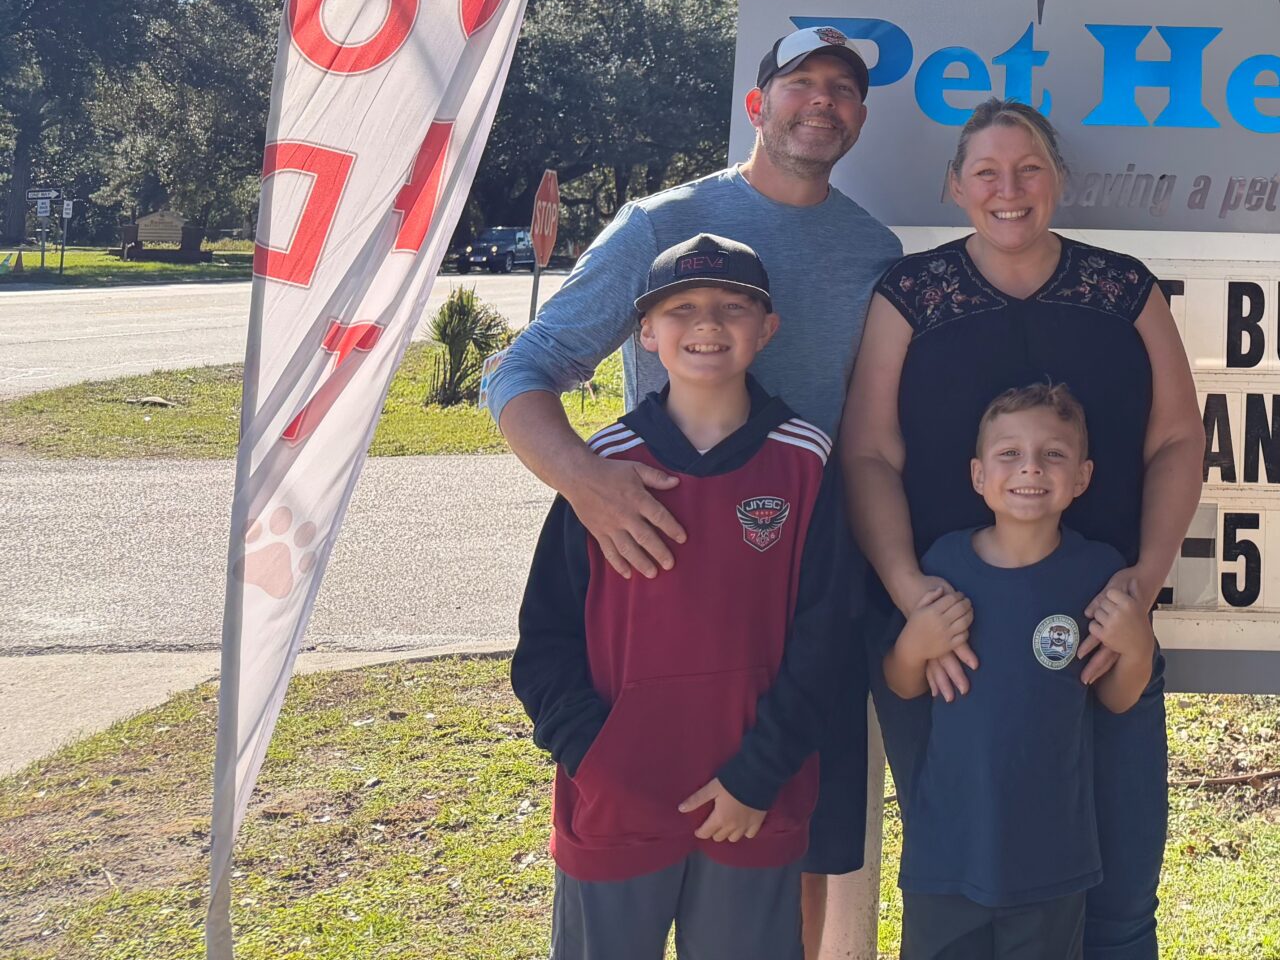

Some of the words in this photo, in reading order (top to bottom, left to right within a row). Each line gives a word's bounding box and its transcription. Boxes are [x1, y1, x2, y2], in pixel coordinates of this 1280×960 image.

[789, 16, 1053, 127] Pet
[1187, 174, 1212, 210] a
[535, 199, 557, 237] STOP
[745, 499, 782, 511] JIYSC
[1158, 512, 1261, 608] -5
